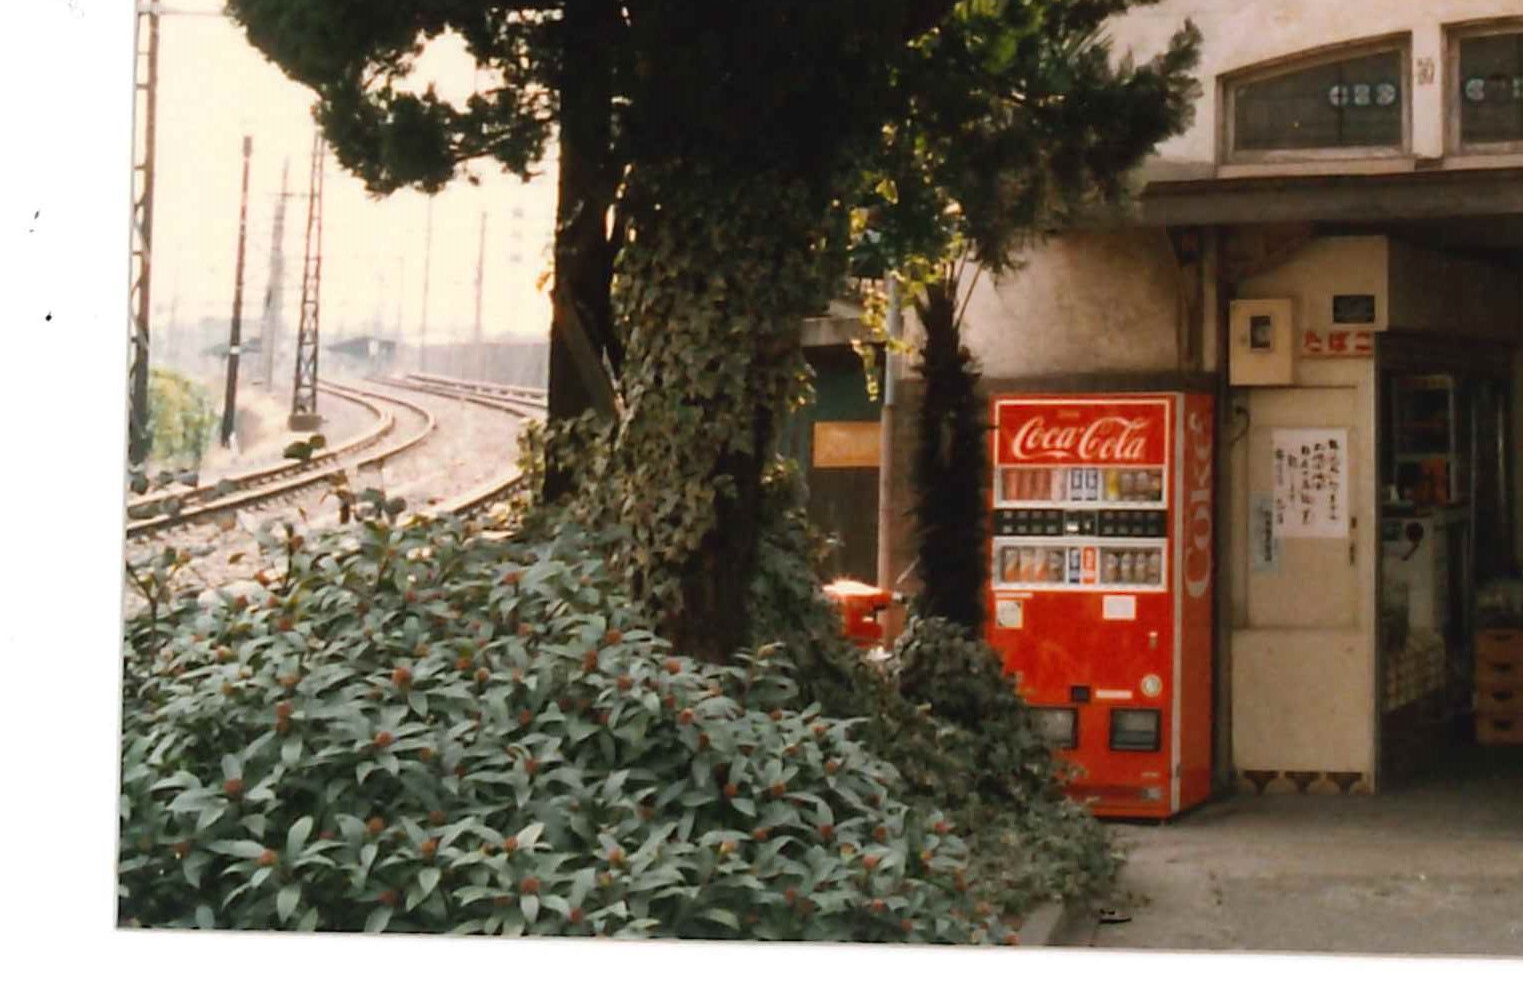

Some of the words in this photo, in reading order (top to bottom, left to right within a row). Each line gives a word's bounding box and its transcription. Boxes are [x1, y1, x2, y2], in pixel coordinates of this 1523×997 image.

[1304, 331, 1372, 353] たばこ
[1012, 416, 1150, 460] Coca-Cola
